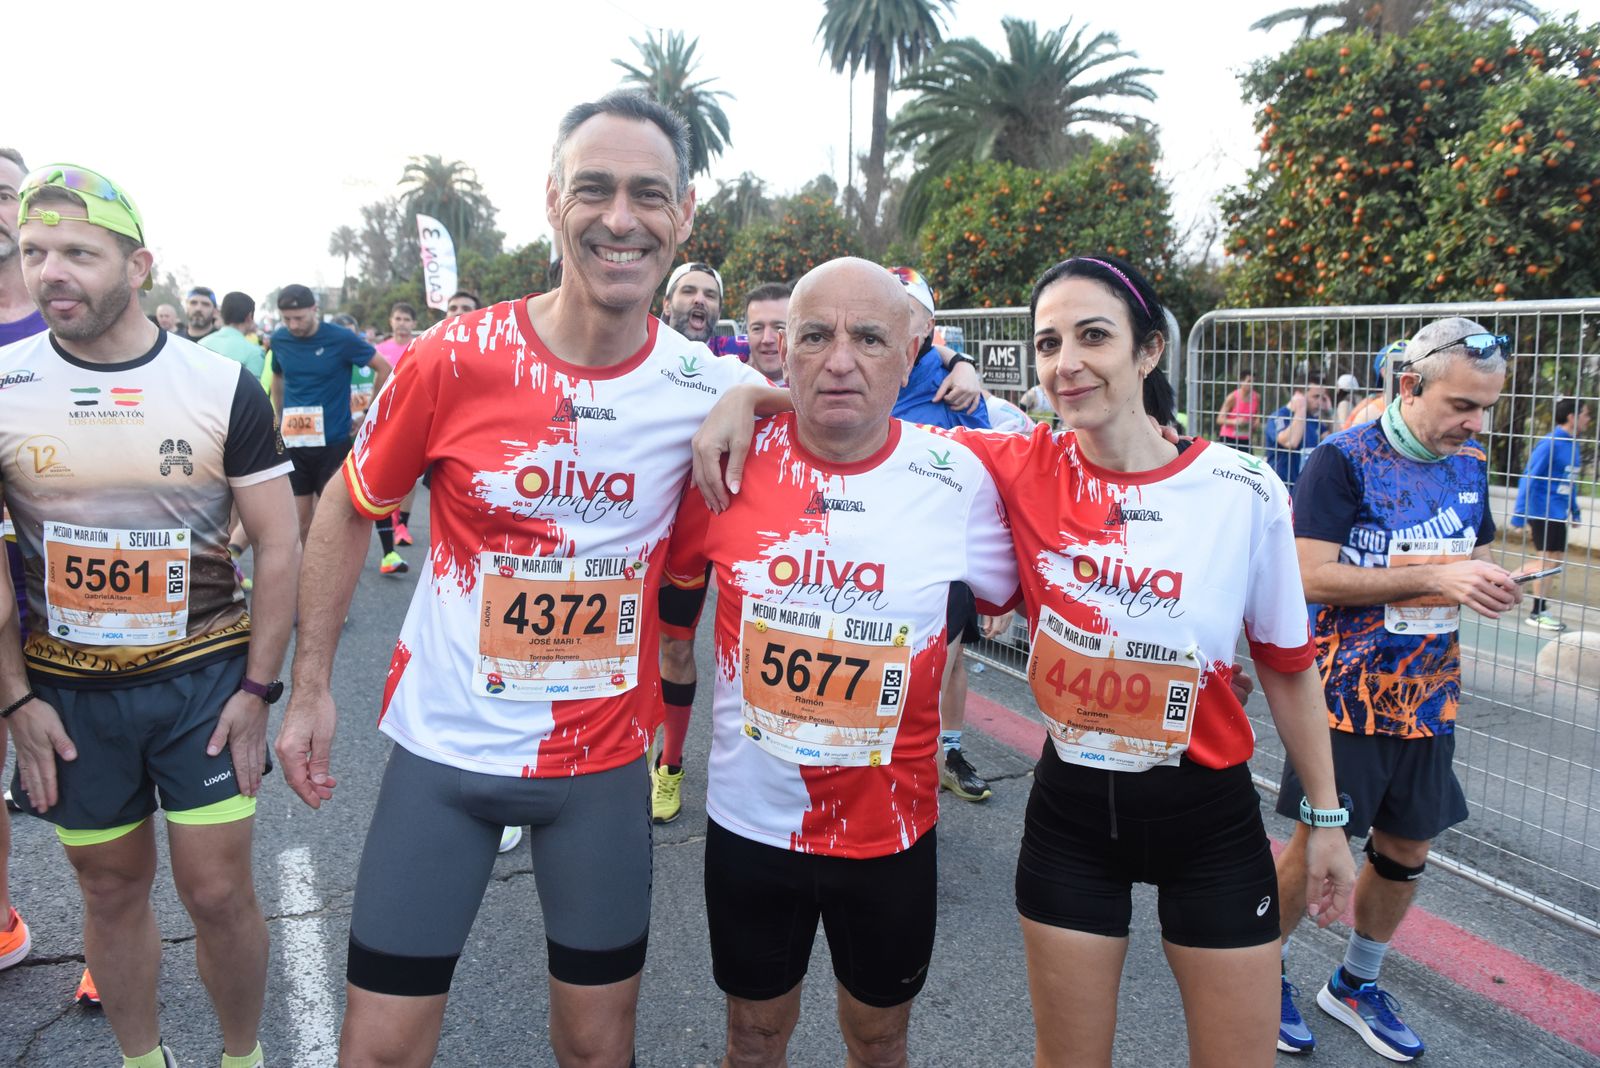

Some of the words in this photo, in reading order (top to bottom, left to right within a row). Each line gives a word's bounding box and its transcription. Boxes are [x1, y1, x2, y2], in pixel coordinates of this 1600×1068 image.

[988, 347, 1015, 366] AMS
[661, 368, 717, 395] Extremadura
[98, 410, 144, 418] MARATÓN
[515, 460, 635, 502] oliva
[908, 462, 963, 493] Extremadura
[1212, 468, 1270, 502] Extremadura
[513, 478, 638, 523] frontera
[53, 525, 72, 539] MEDIO
[74, 529, 108, 543] MARATÓN
[129, 531, 171, 547] SEVILLA
[1349, 527, 1386, 552] EDIO
[1392, 507, 1463, 540] MARATÓN
[65, 555, 149, 594] 5561
[493, 555, 519, 571] MEDIO
[521, 557, 563, 574] MARATÓN
[585, 558, 627, 578] SEVILLA
[768, 549, 885, 593] oliva
[1073, 555, 1183, 599] oliva
[767, 569, 889, 614] frontera
[1063, 574, 1186, 618] frontera
[503, 592, 607, 636] 4372
[752, 602, 777, 621] MEDIO
[779, 608, 821, 629] MARATÓN
[844, 618, 893, 642] SEVILLA
[1046, 614, 1063, 635] MEDIO
[1063, 626, 1102, 651] MARATÓN
[1126, 641, 1178, 662] SEVILLA
[545, 685, 569, 693] HOKA
[760, 642, 870, 701] 5677
[1045, 657, 1151, 714] 4409
[795, 695, 824, 707] Ramón
[1076, 708, 1109, 719] Carmen
[1095, 726, 1115, 734] pardo
[795, 747, 821, 758] HOKA
[1080, 751, 1105, 761] HOKA
